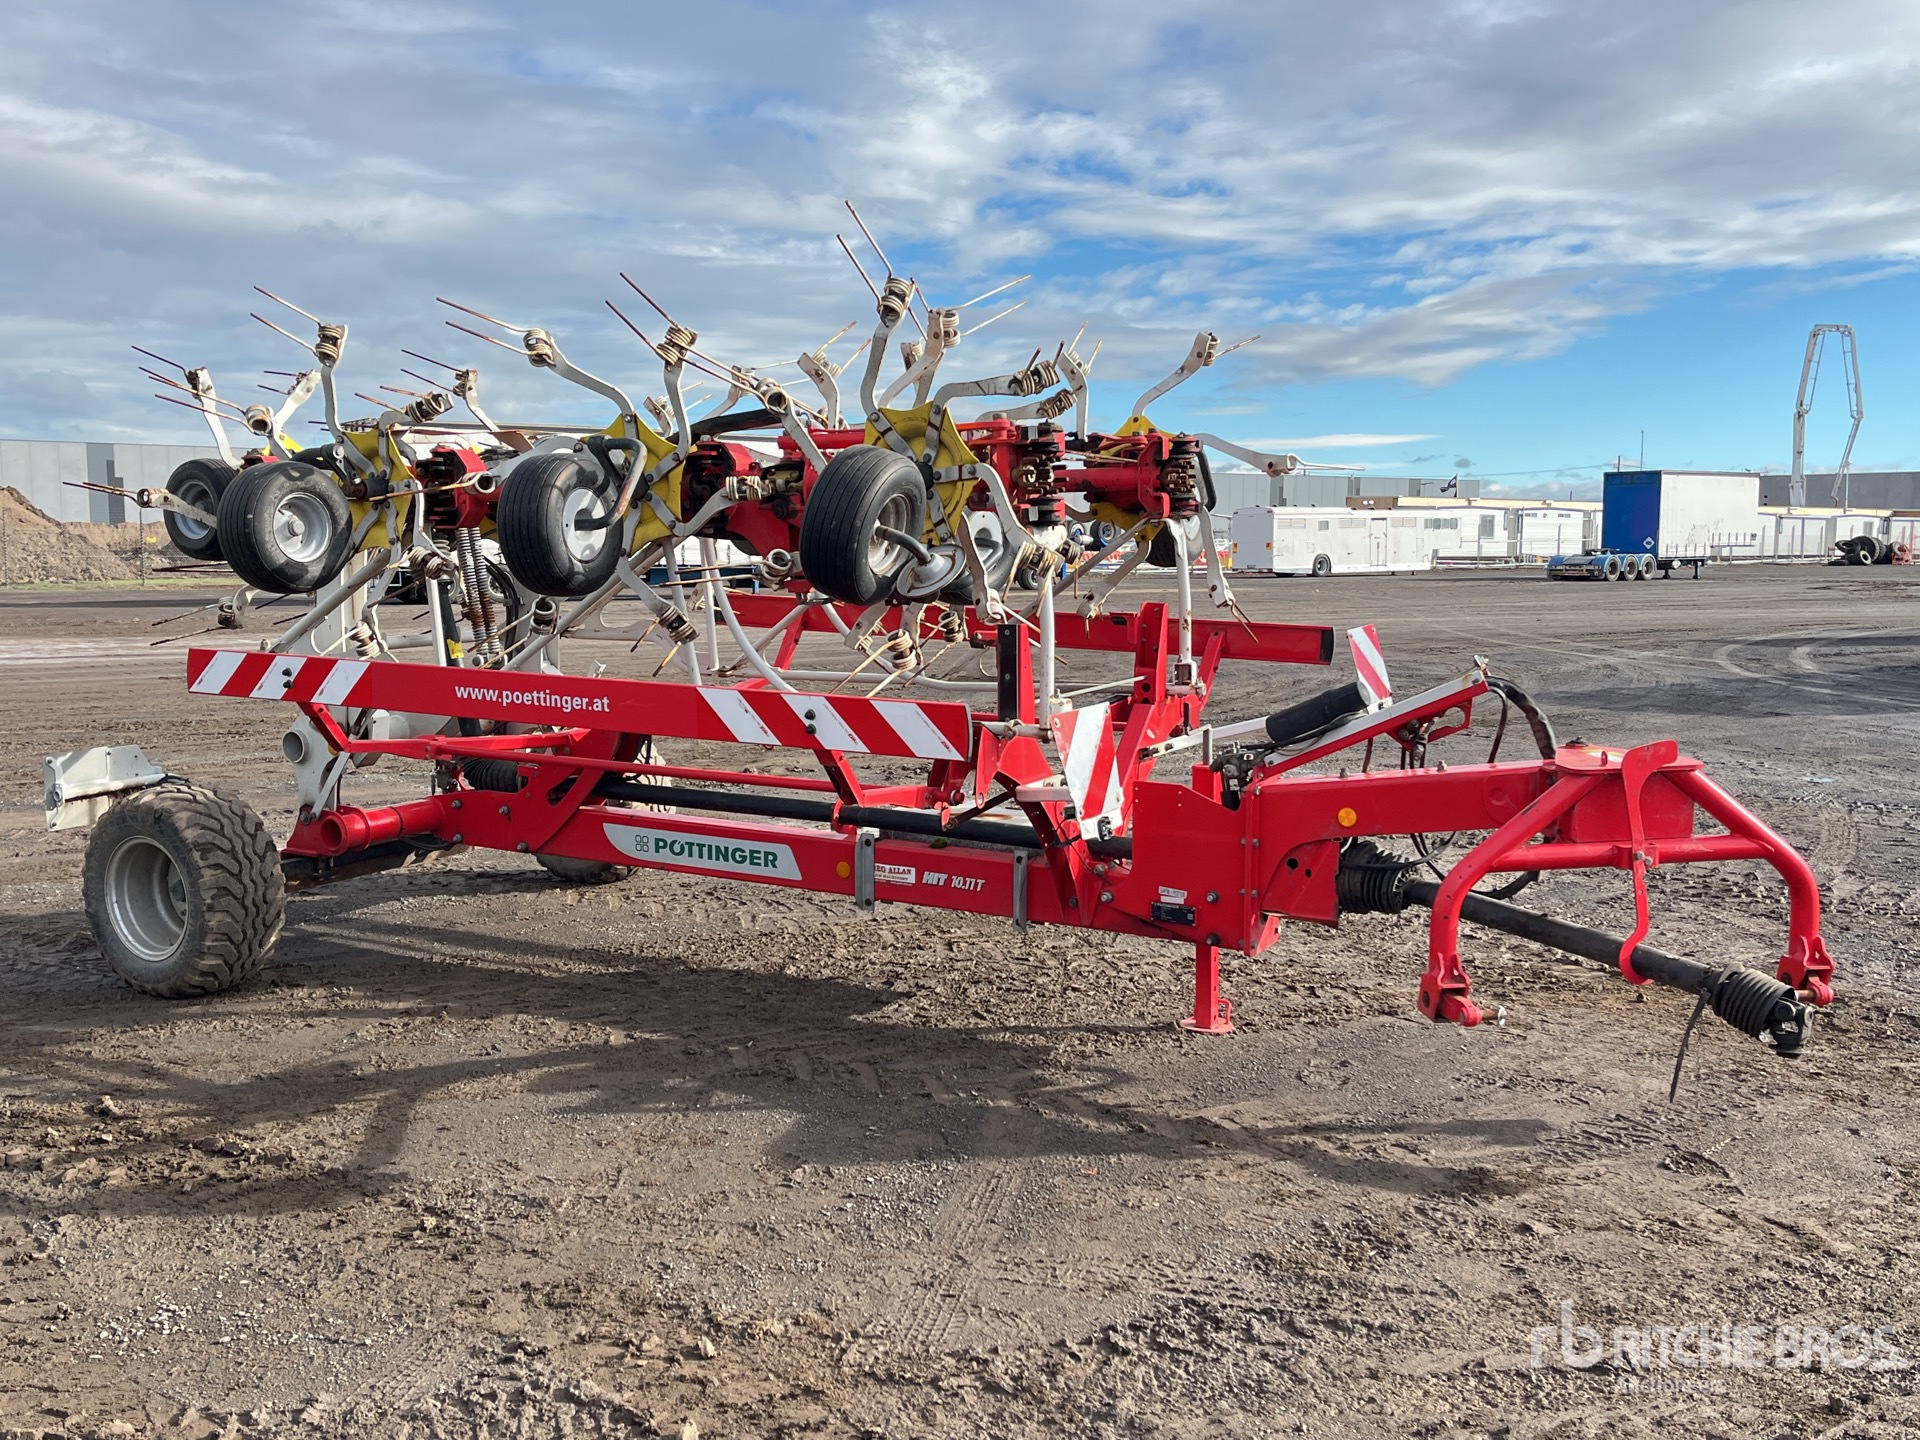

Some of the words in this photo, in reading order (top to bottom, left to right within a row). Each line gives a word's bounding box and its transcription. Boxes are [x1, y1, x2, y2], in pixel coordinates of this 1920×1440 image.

[454, 685, 610, 713] www.poettinger.at
[888, 866, 912, 876] ALLAN
[922, 871, 949, 886] HIT
